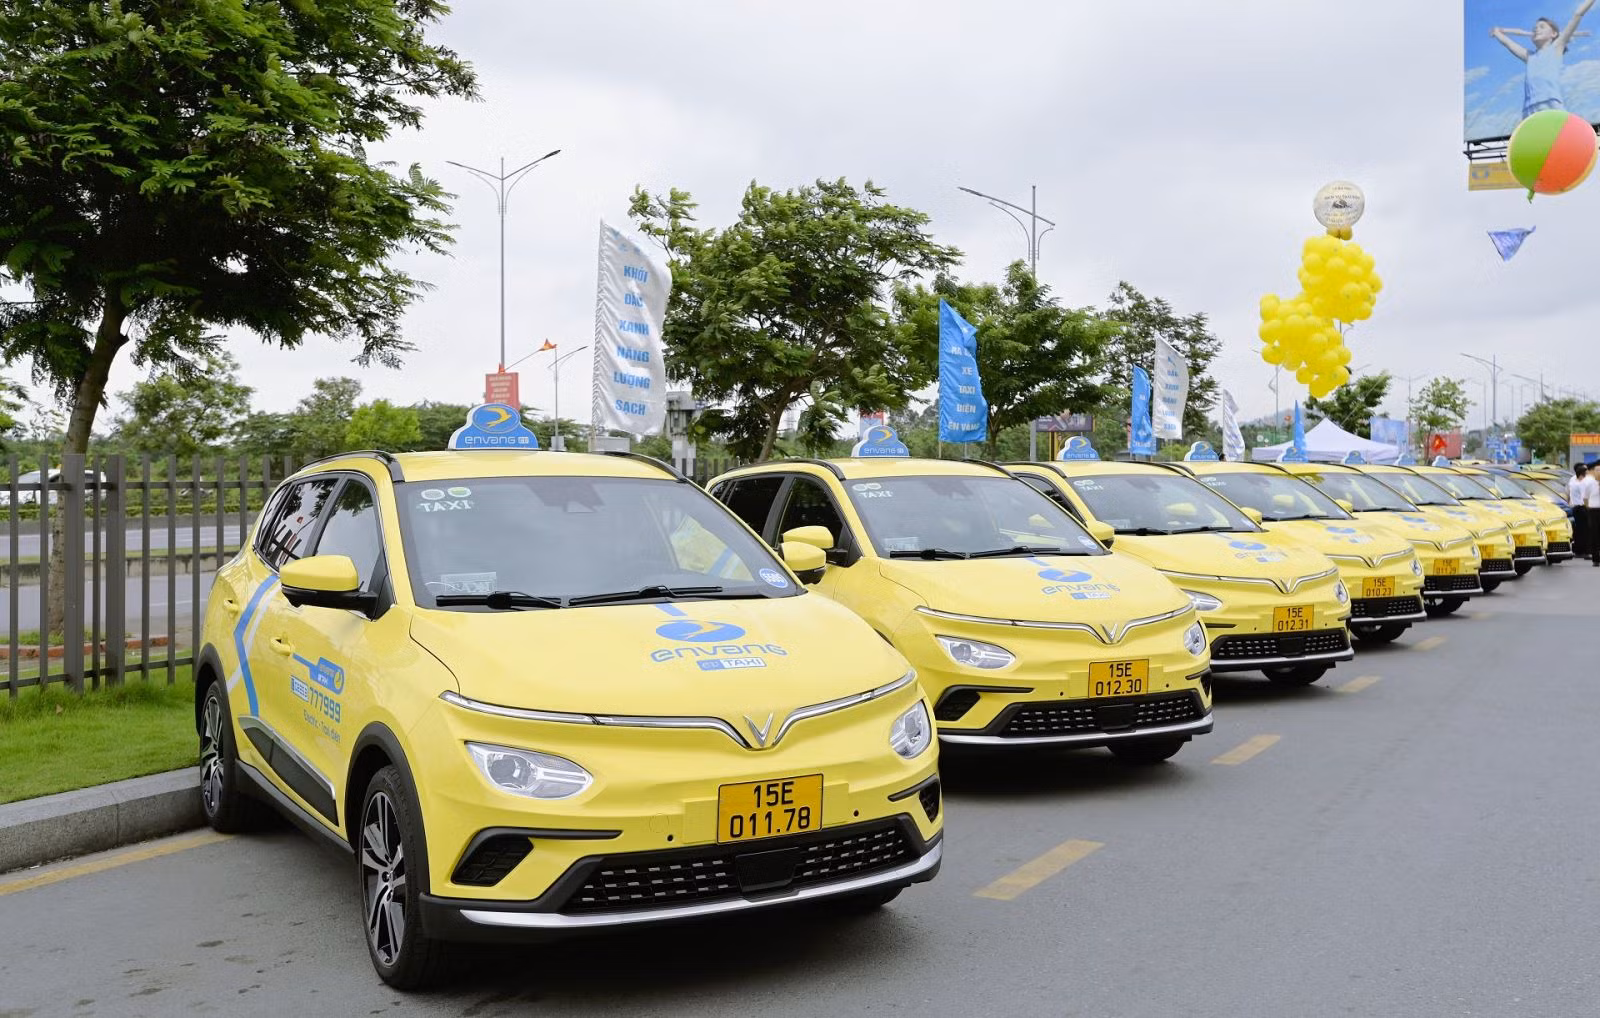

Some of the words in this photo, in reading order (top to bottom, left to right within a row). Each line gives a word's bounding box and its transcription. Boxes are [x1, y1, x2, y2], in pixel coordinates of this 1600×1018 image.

[619, 319, 649, 335] XANH
[615, 399, 646, 416] SẠCH
[860, 490, 892, 498] TAXI
[420, 499, 472, 513] TAXI
[1373, 578, 1386, 587] 15E
[1287, 607, 1303, 618] 15E
[1278, 619, 1309, 631] 012.31
[1109, 662, 1132, 678] 15E
[1095, 678, 1142, 696] 012.30
[310, 686, 340, 724] 777999
[753, 781, 794, 808] 15E
[729, 806, 811, 838] 011.78
